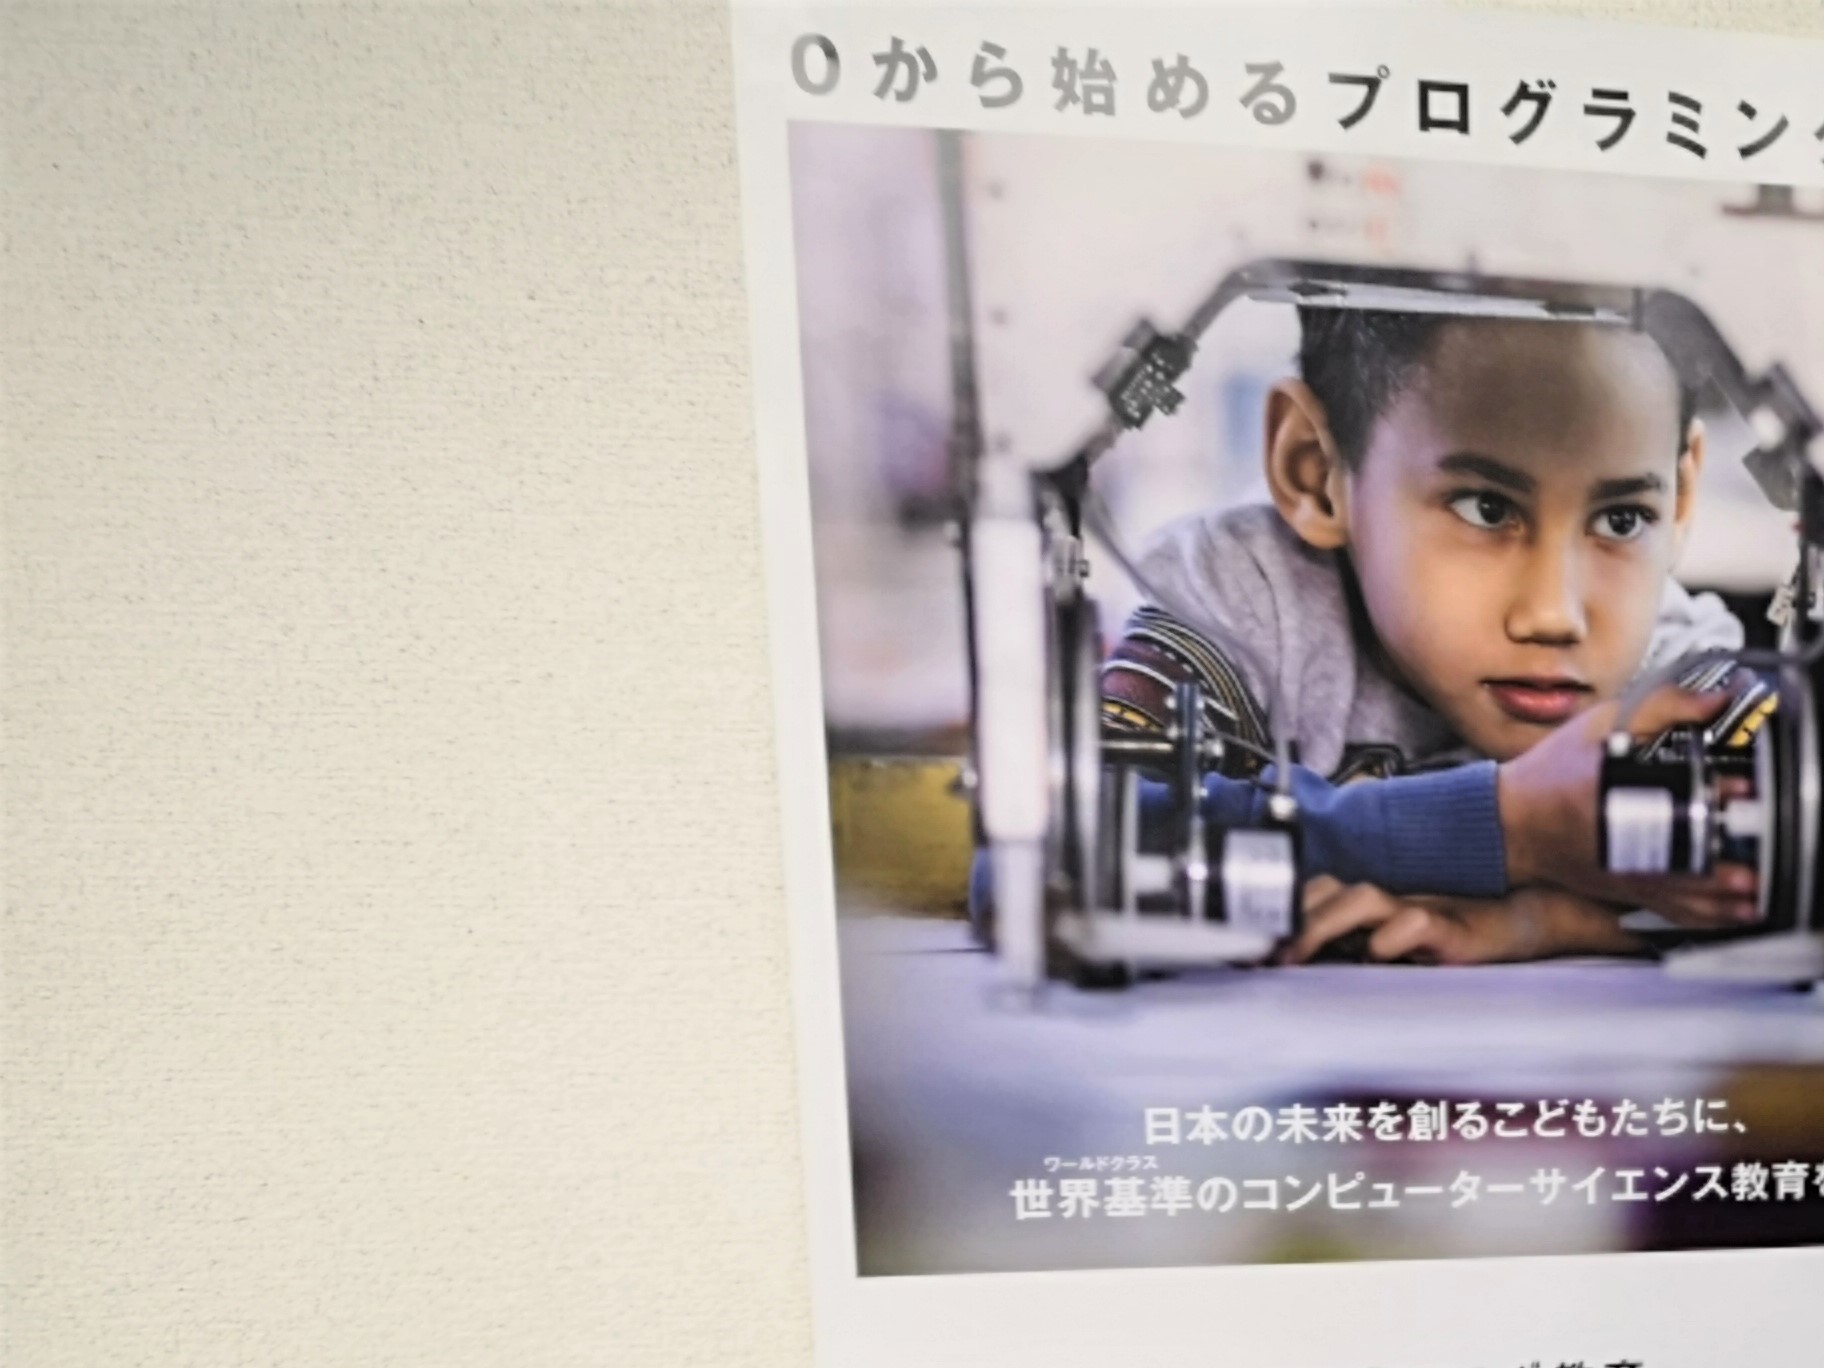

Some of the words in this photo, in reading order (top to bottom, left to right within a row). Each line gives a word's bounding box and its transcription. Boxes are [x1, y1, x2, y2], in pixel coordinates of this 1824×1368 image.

[1143, 1098, 1748, 1145] 日本の未来を創るこどもたちに、
[1044, 1154, 1159, 1173] ワールドクラス
